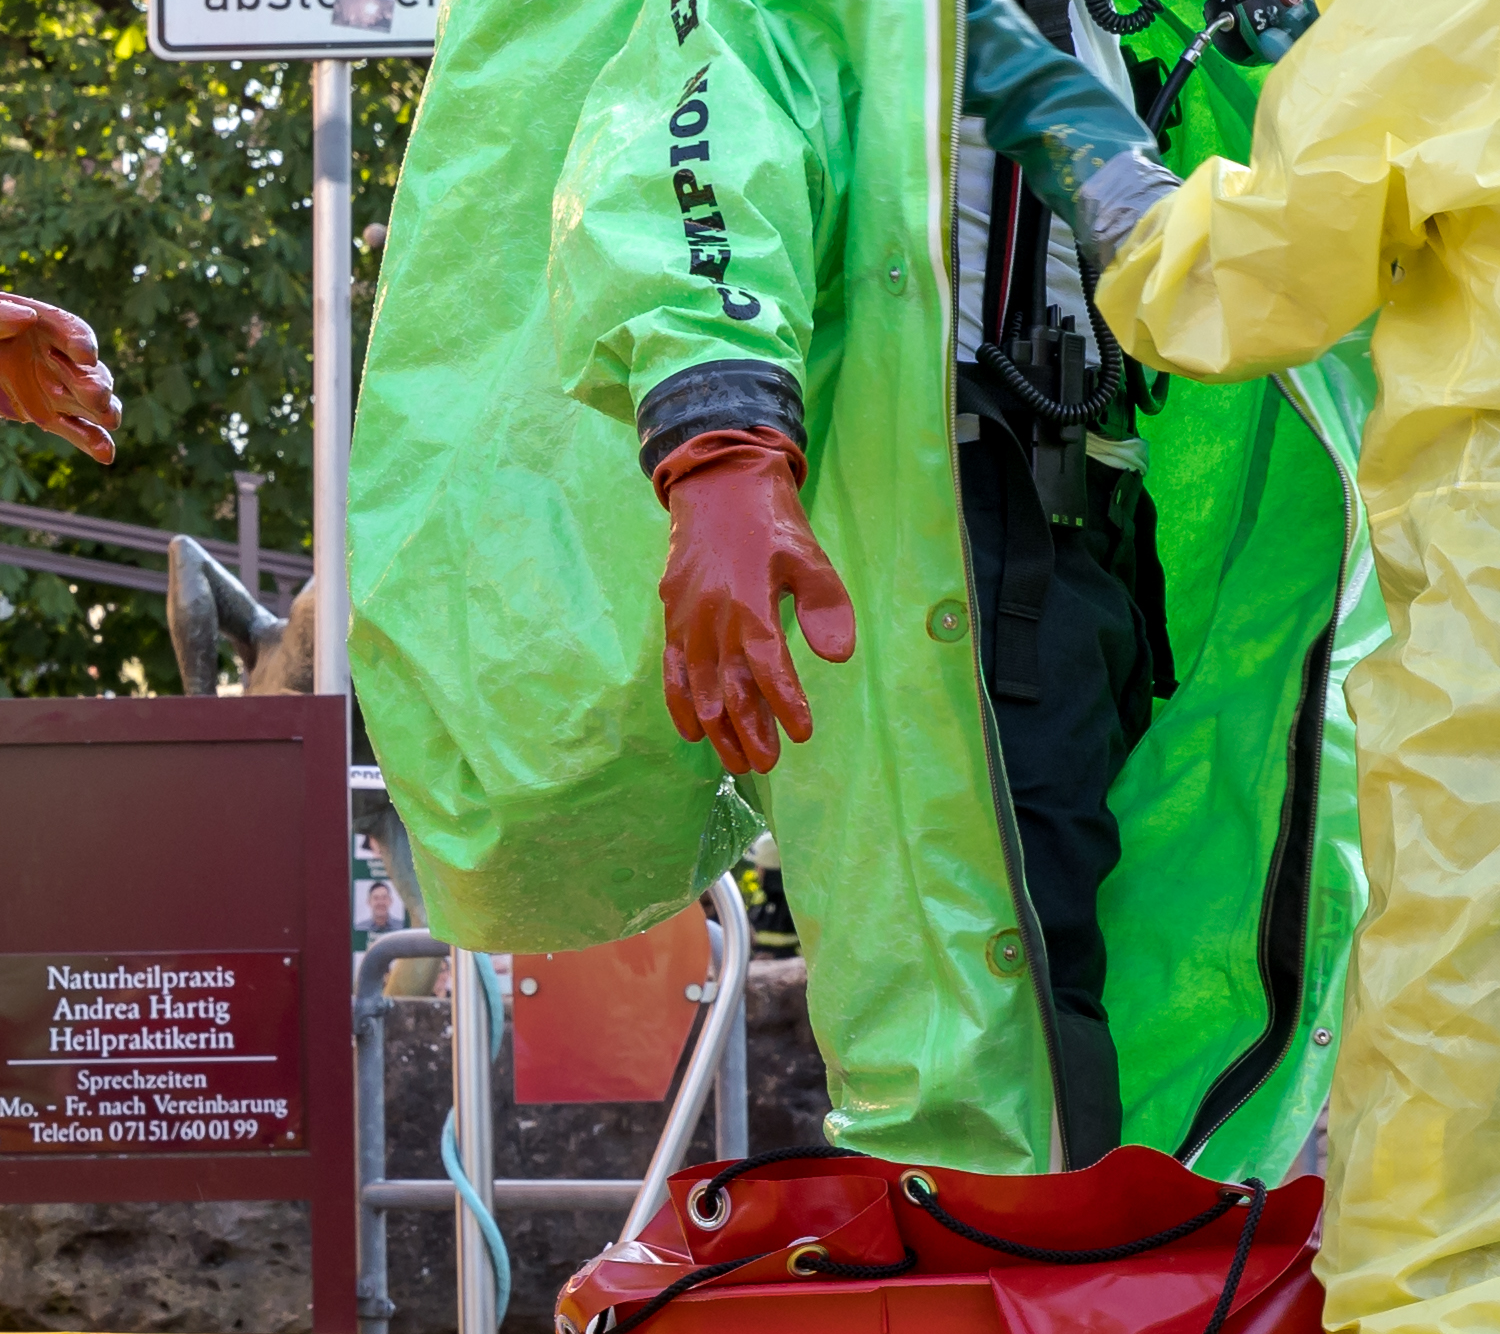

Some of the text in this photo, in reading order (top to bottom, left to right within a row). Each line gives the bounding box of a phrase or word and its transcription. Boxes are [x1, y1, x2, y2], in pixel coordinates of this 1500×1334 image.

[47, 965, 235, 995] Naturheilpraxis
[53, 994, 231, 1025] Andrea Hartig
[49, 1026, 235, 1057] Heilpraktikerin
[77, 1069, 208, 1095] Sprechzeiten
[65, 1095, 93, 1116] Fr.
[99, 1095, 146, 1115] nach
[153, 1094, 288, 1118] Vereinbarung
[29, 1121, 103, 1143] Telefon
